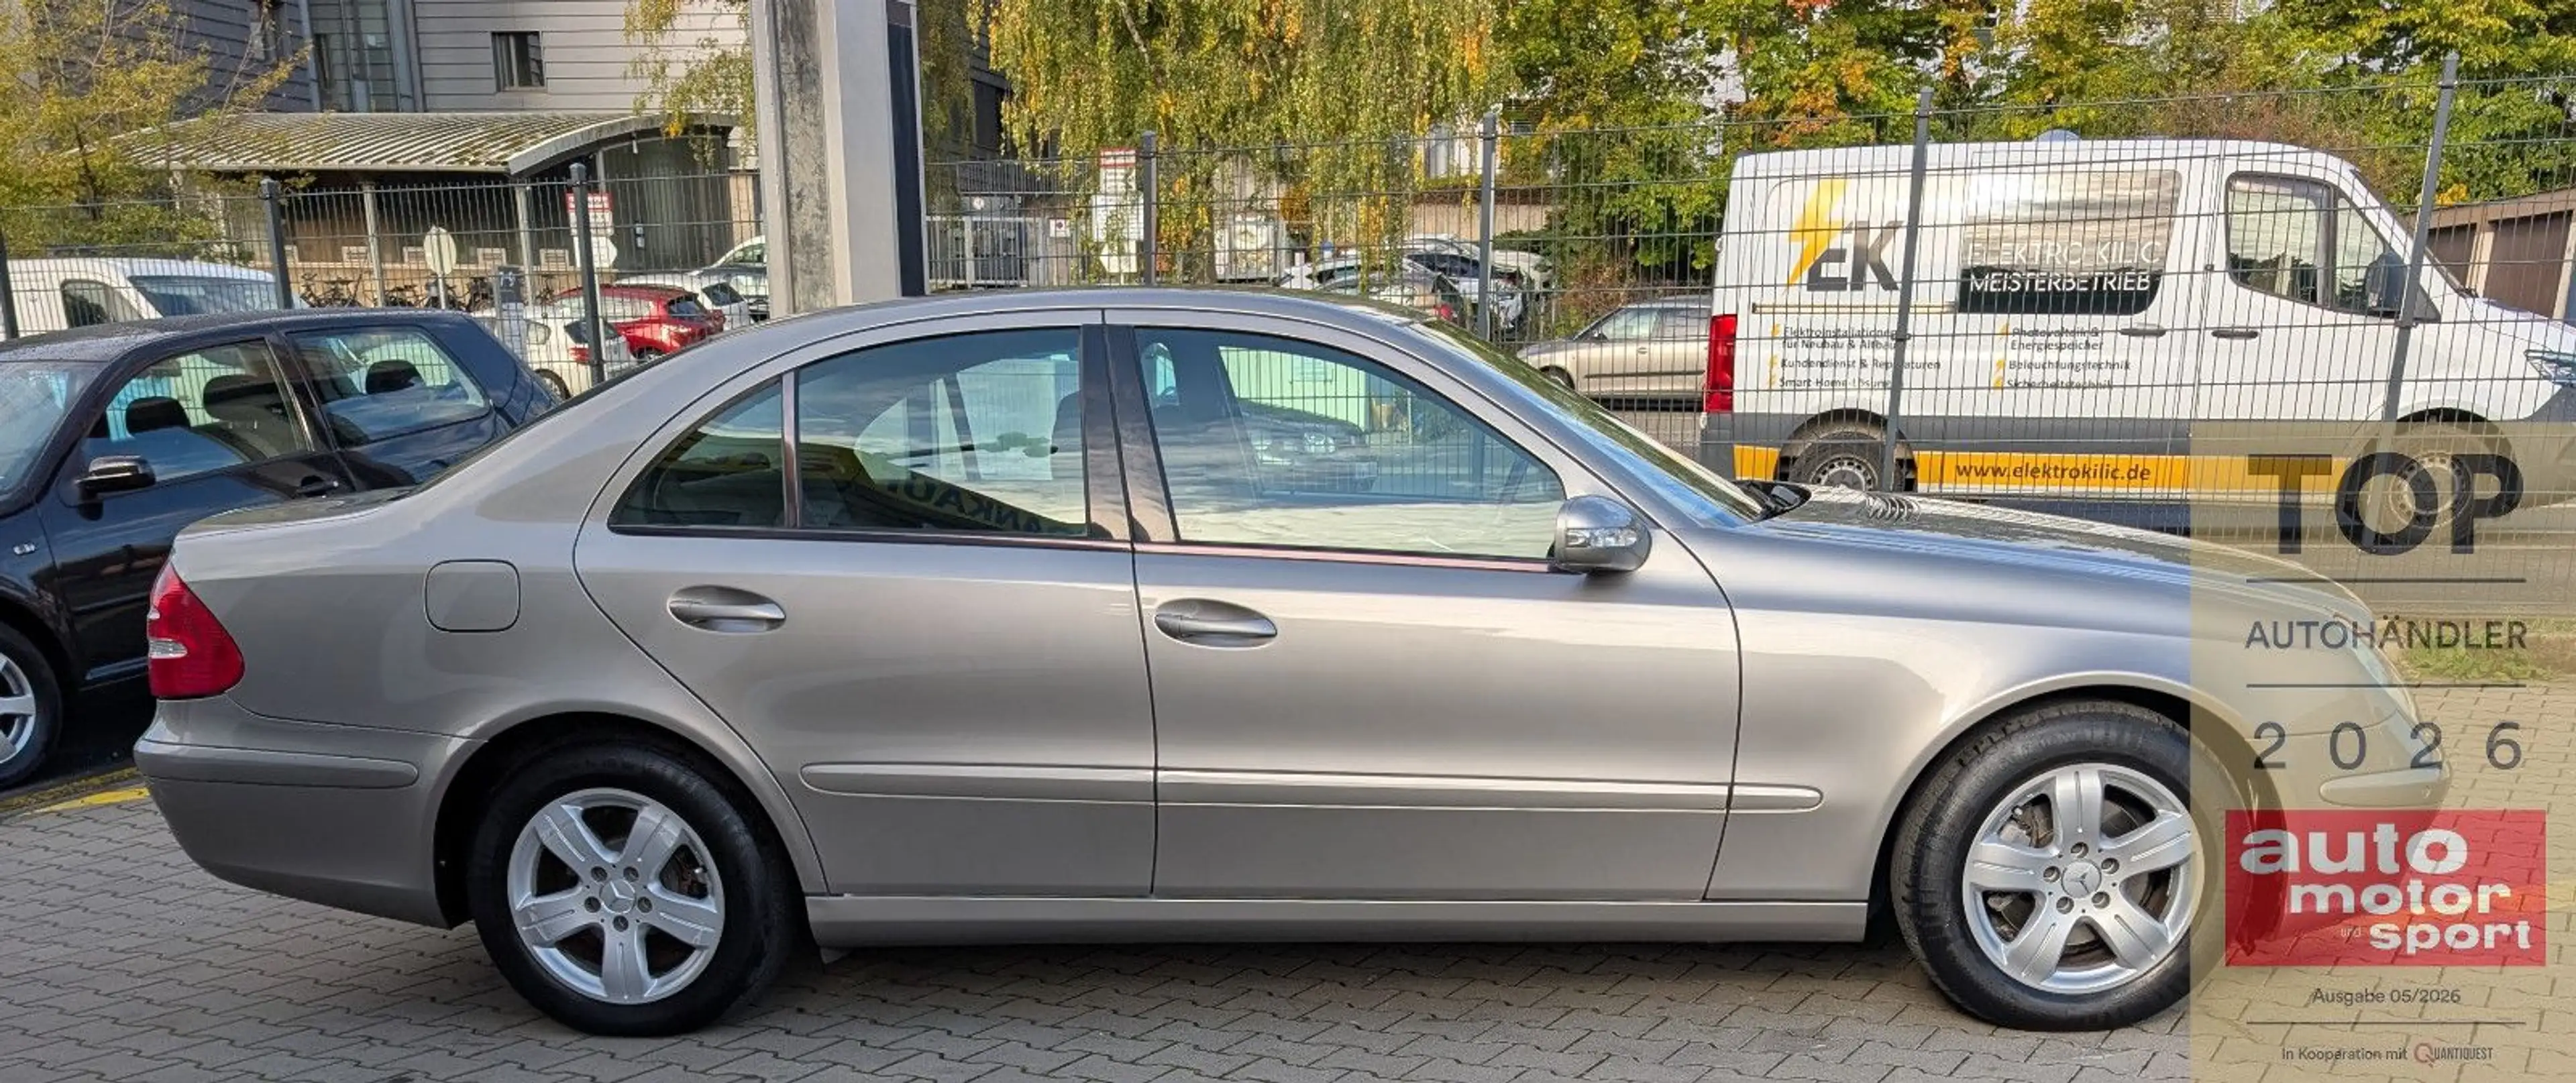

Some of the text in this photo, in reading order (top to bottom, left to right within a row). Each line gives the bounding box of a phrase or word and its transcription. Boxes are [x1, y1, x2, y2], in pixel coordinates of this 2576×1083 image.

[1807, 221, 1904, 291] EK
[1968, 241, 2160, 265] ELEKTRO KILIC
[1970, 272, 2150, 292] MEISTERBETRIEB
[1802, 339, 1843, 349] Neubau
[1848, 340, 1856, 349] &
[2011, 341, 2102, 353] Energiespeicher
[1781, 358, 1856, 369] Kundendienst
[2009, 360, 2130, 372] Beleuchtungstechnik
[1955, 463, 2151, 480] www.elektrokilic.de
